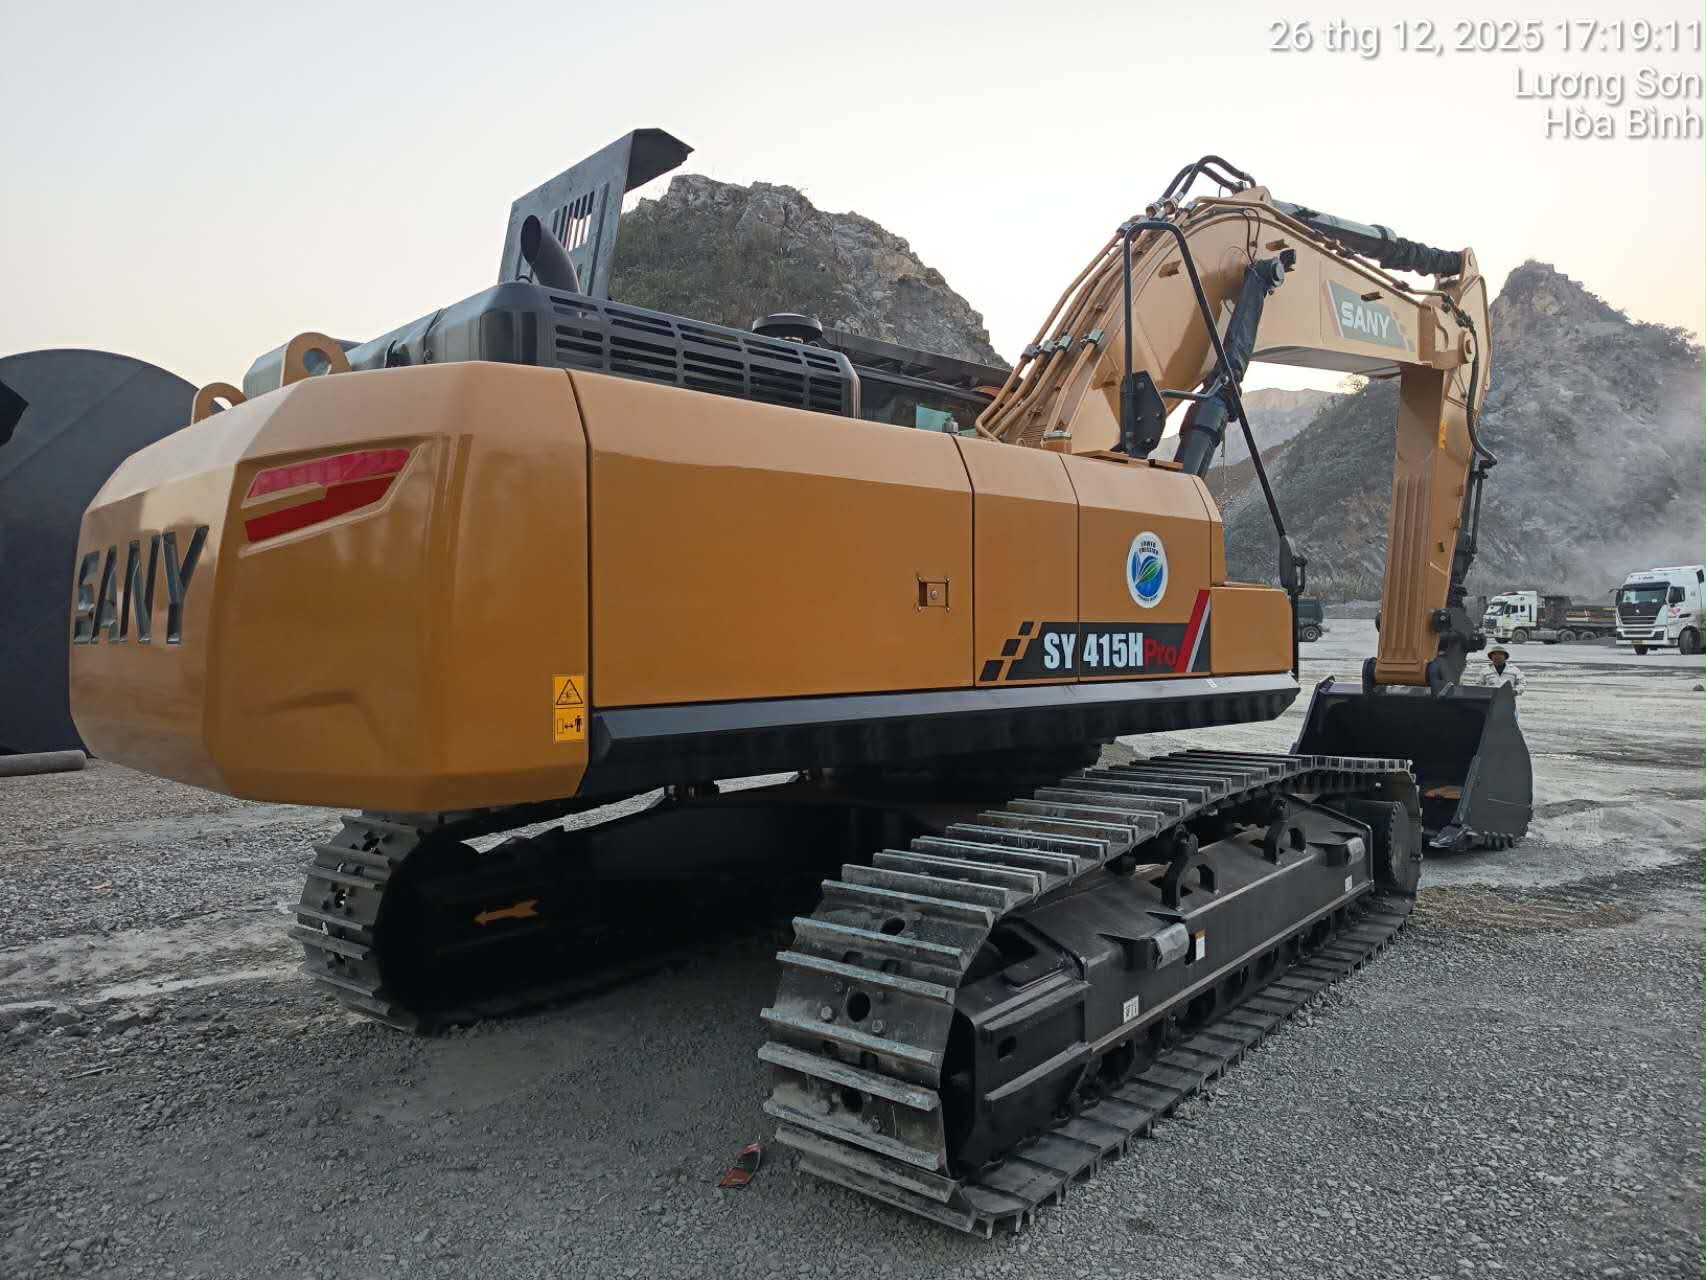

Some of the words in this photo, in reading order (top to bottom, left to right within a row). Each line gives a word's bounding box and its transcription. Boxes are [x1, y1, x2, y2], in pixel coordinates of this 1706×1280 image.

[1341, 301, 1391, 338] SANY
[73, 525, 210, 645] SANY
[1043, 632, 1077, 669] SY
